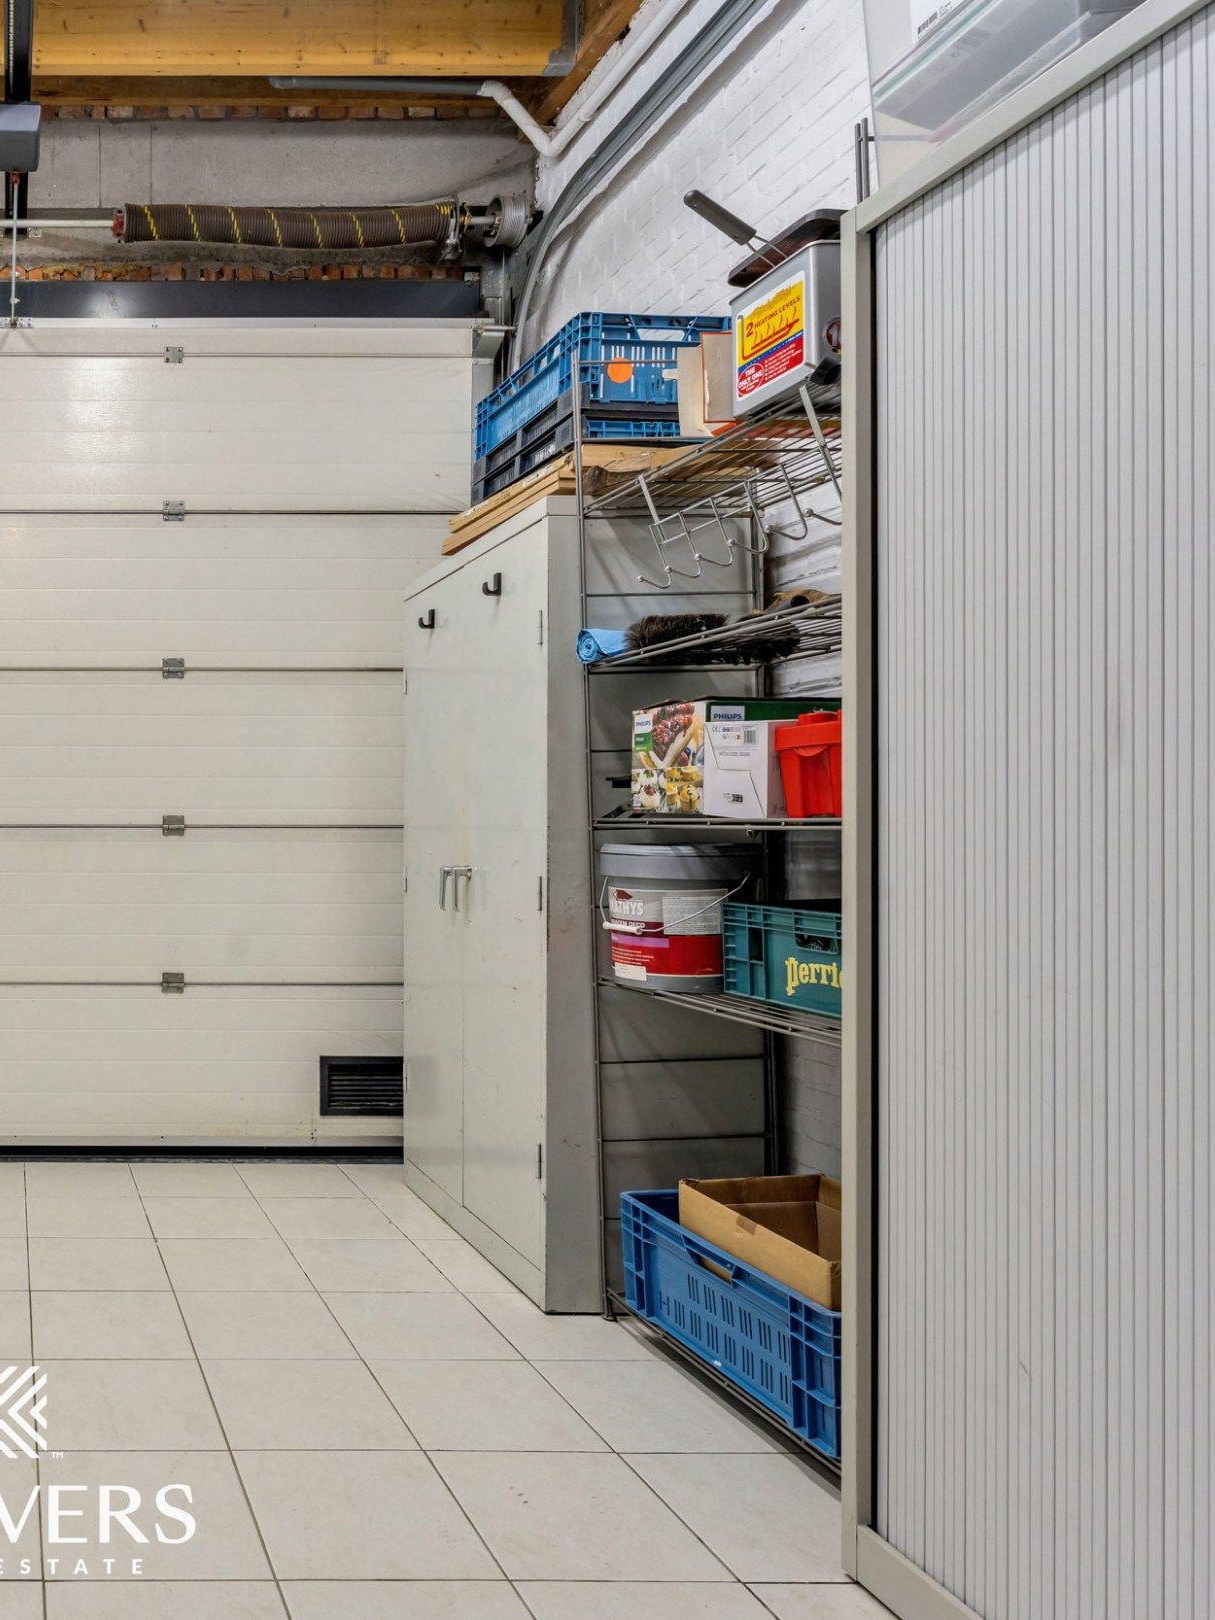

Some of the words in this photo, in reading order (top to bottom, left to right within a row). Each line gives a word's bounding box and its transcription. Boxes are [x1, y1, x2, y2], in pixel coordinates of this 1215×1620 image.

[746, 322, 753, 337] 2
[754, 310, 777, 328] HEATING
[779, 296, 800, 314] LEVELS
[745, 366, 755, 377] THE
[752, 370, 763, 381] ONE
[636, 720, 651, 728] PHILIPS
[785, 956, 842, 996] perri
